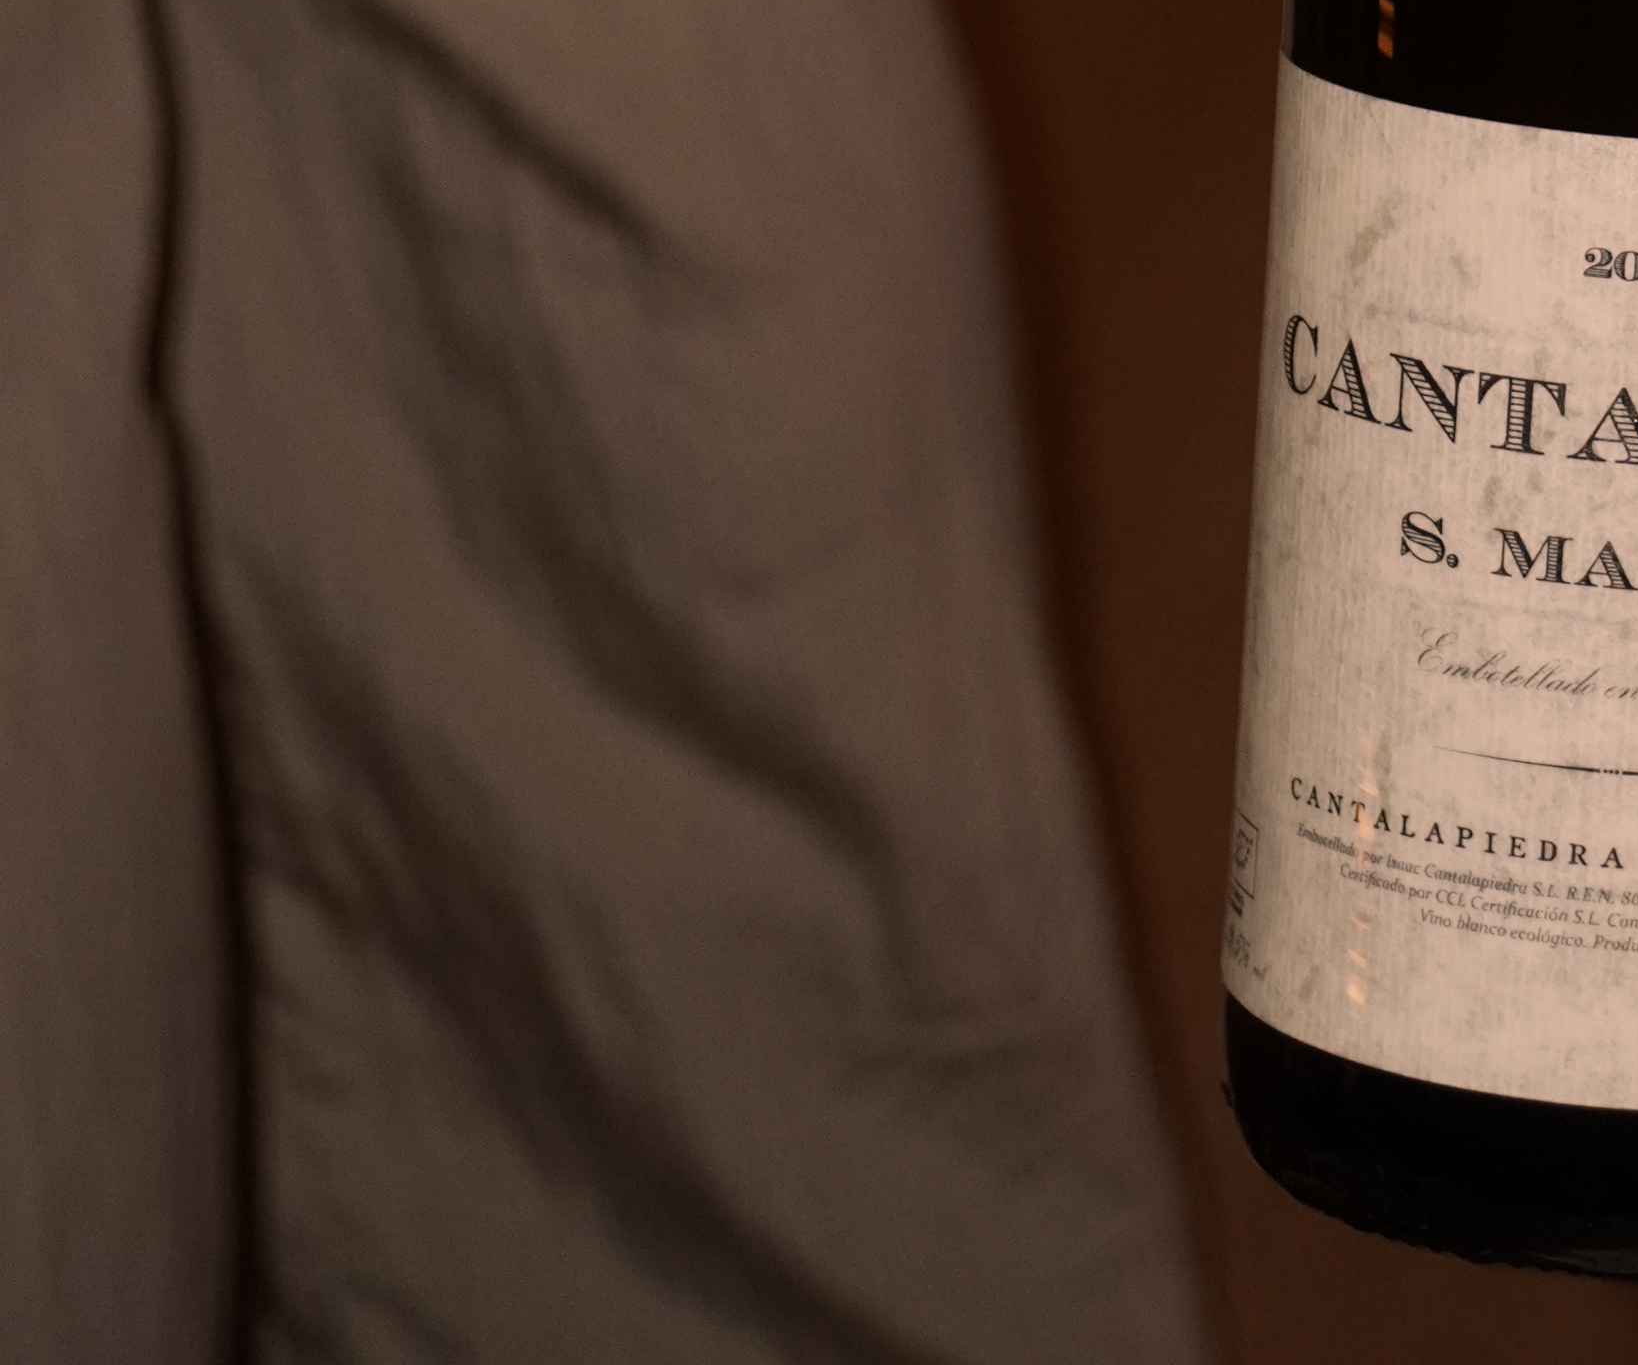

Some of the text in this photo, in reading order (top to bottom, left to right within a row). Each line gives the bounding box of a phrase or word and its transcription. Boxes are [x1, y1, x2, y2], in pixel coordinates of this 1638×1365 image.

[1400, 511, 1461, 569] S.
[1417, 627, 1600, 696] Embotellado
[1290, 777, 1625, 870] CANTALAPIEDRA
[1297, 823, 1360, 859] Embotellado
[1361, 849, 1384, 866] por
[1423, 863, 1529, 896] Cantalapiedra
[1531, 880, 1560, 900] S.L.
[1566, 885, 1615, 905] R.E.N.
[1340, 862, 1406, 894] Certificado
[1408, 885, 1433, 900] por
[1434, 888, 1467, 908] CCL
[1469, 894, 1569, 924] Certificación
[1420, 907, 1452, 928] Vino
[1456, 913, 1507, 938] blanco
[1509, 927, 1587, 950] ecológico.
